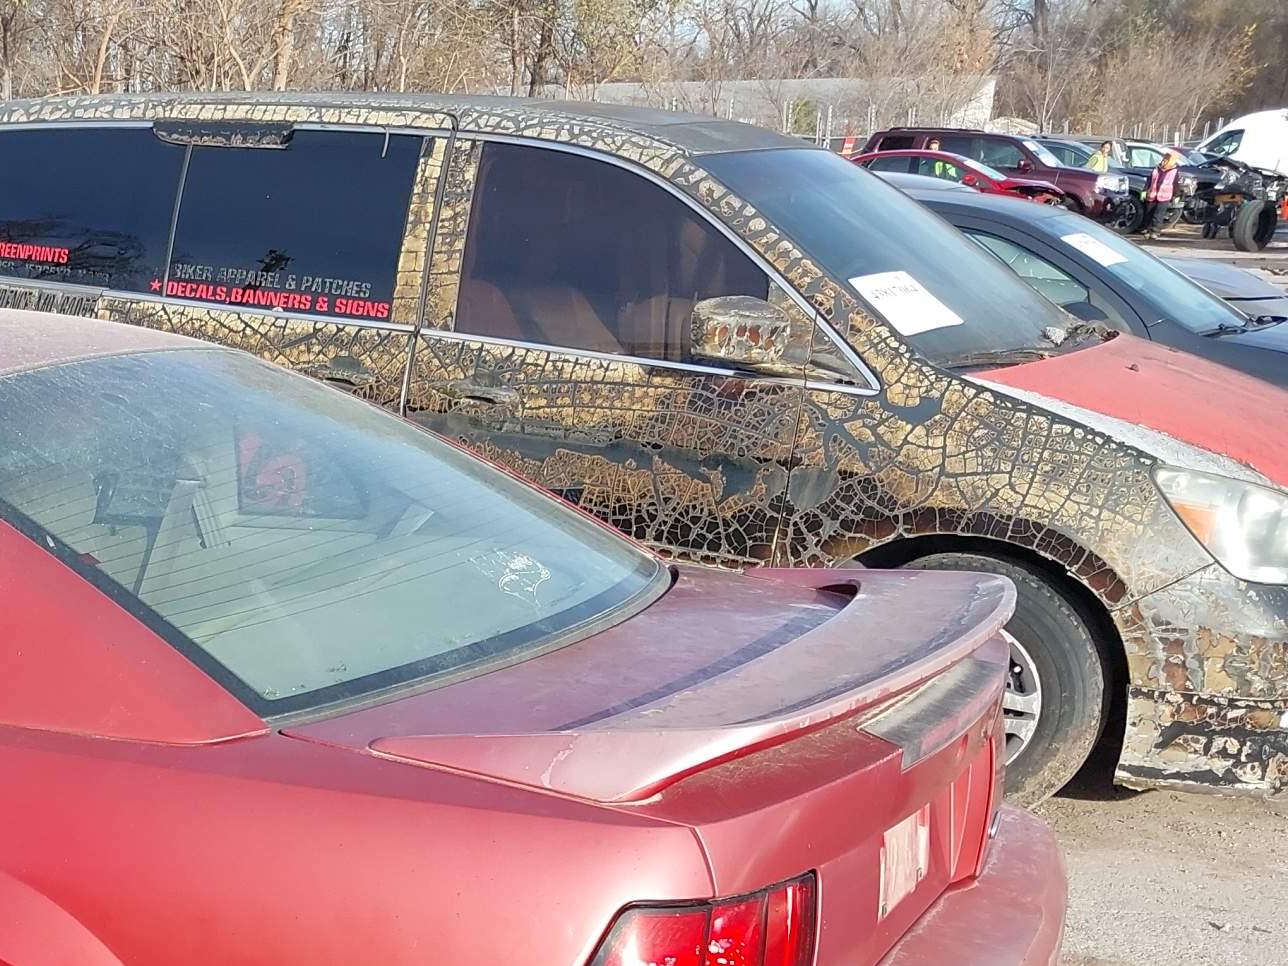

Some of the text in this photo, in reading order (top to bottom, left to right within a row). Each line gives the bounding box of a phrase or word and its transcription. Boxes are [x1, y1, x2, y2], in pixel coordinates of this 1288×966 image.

[216, 267, 281, 290] APPAREL
[285, 274, 298, 290] &
[300, 275, 373, 299] PATCHES
[315, 296, 329, 313] &
[334, 298, 392, 319] SIGNS
